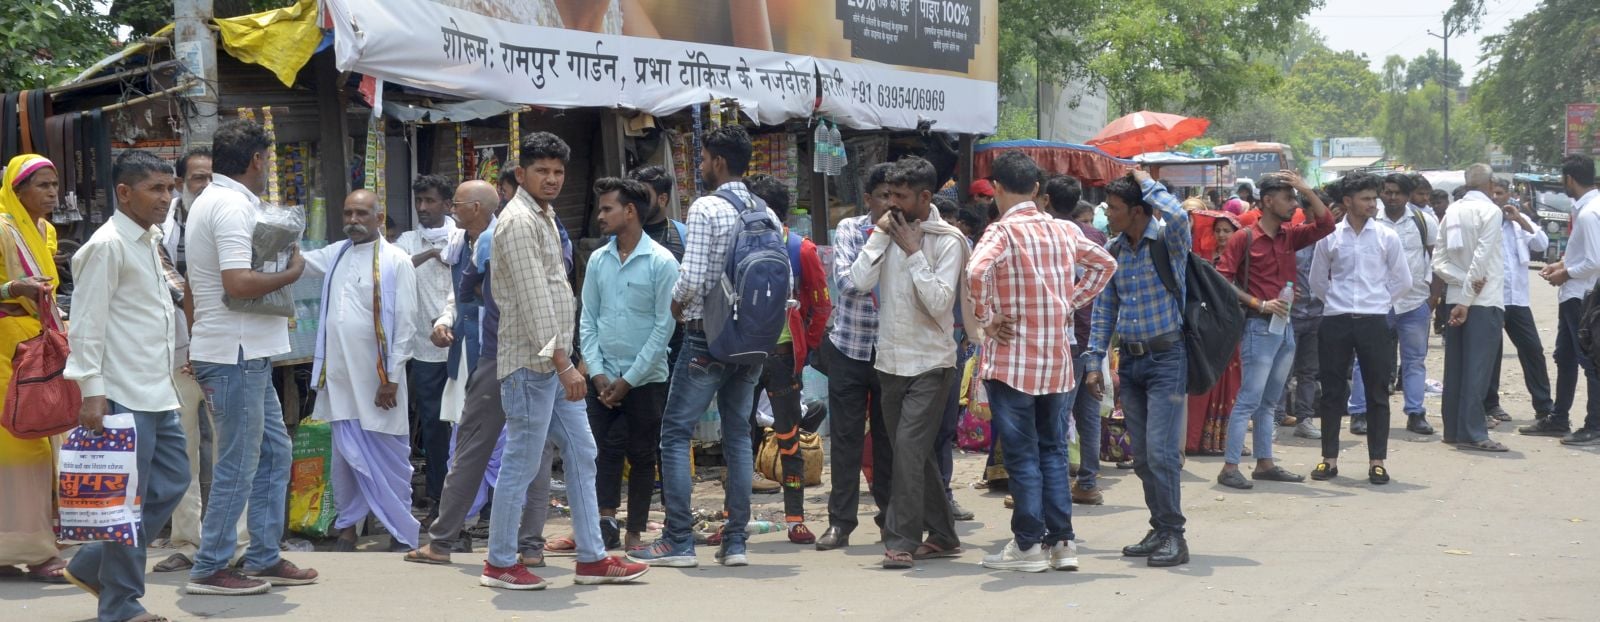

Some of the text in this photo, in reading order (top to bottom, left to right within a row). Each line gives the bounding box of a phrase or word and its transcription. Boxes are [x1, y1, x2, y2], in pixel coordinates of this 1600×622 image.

[441, 18, 494, 69] शोरूम:
[499, 42, 560, 89] रामपुर
[633, 56, 672, 86] प्रभा
[736, 57, 753, 91] के
[755, 61, 812, 100] नज़दीक
[877, 84, 946, 112] 6395406969
[60, 473, 127, 497] सुपर
